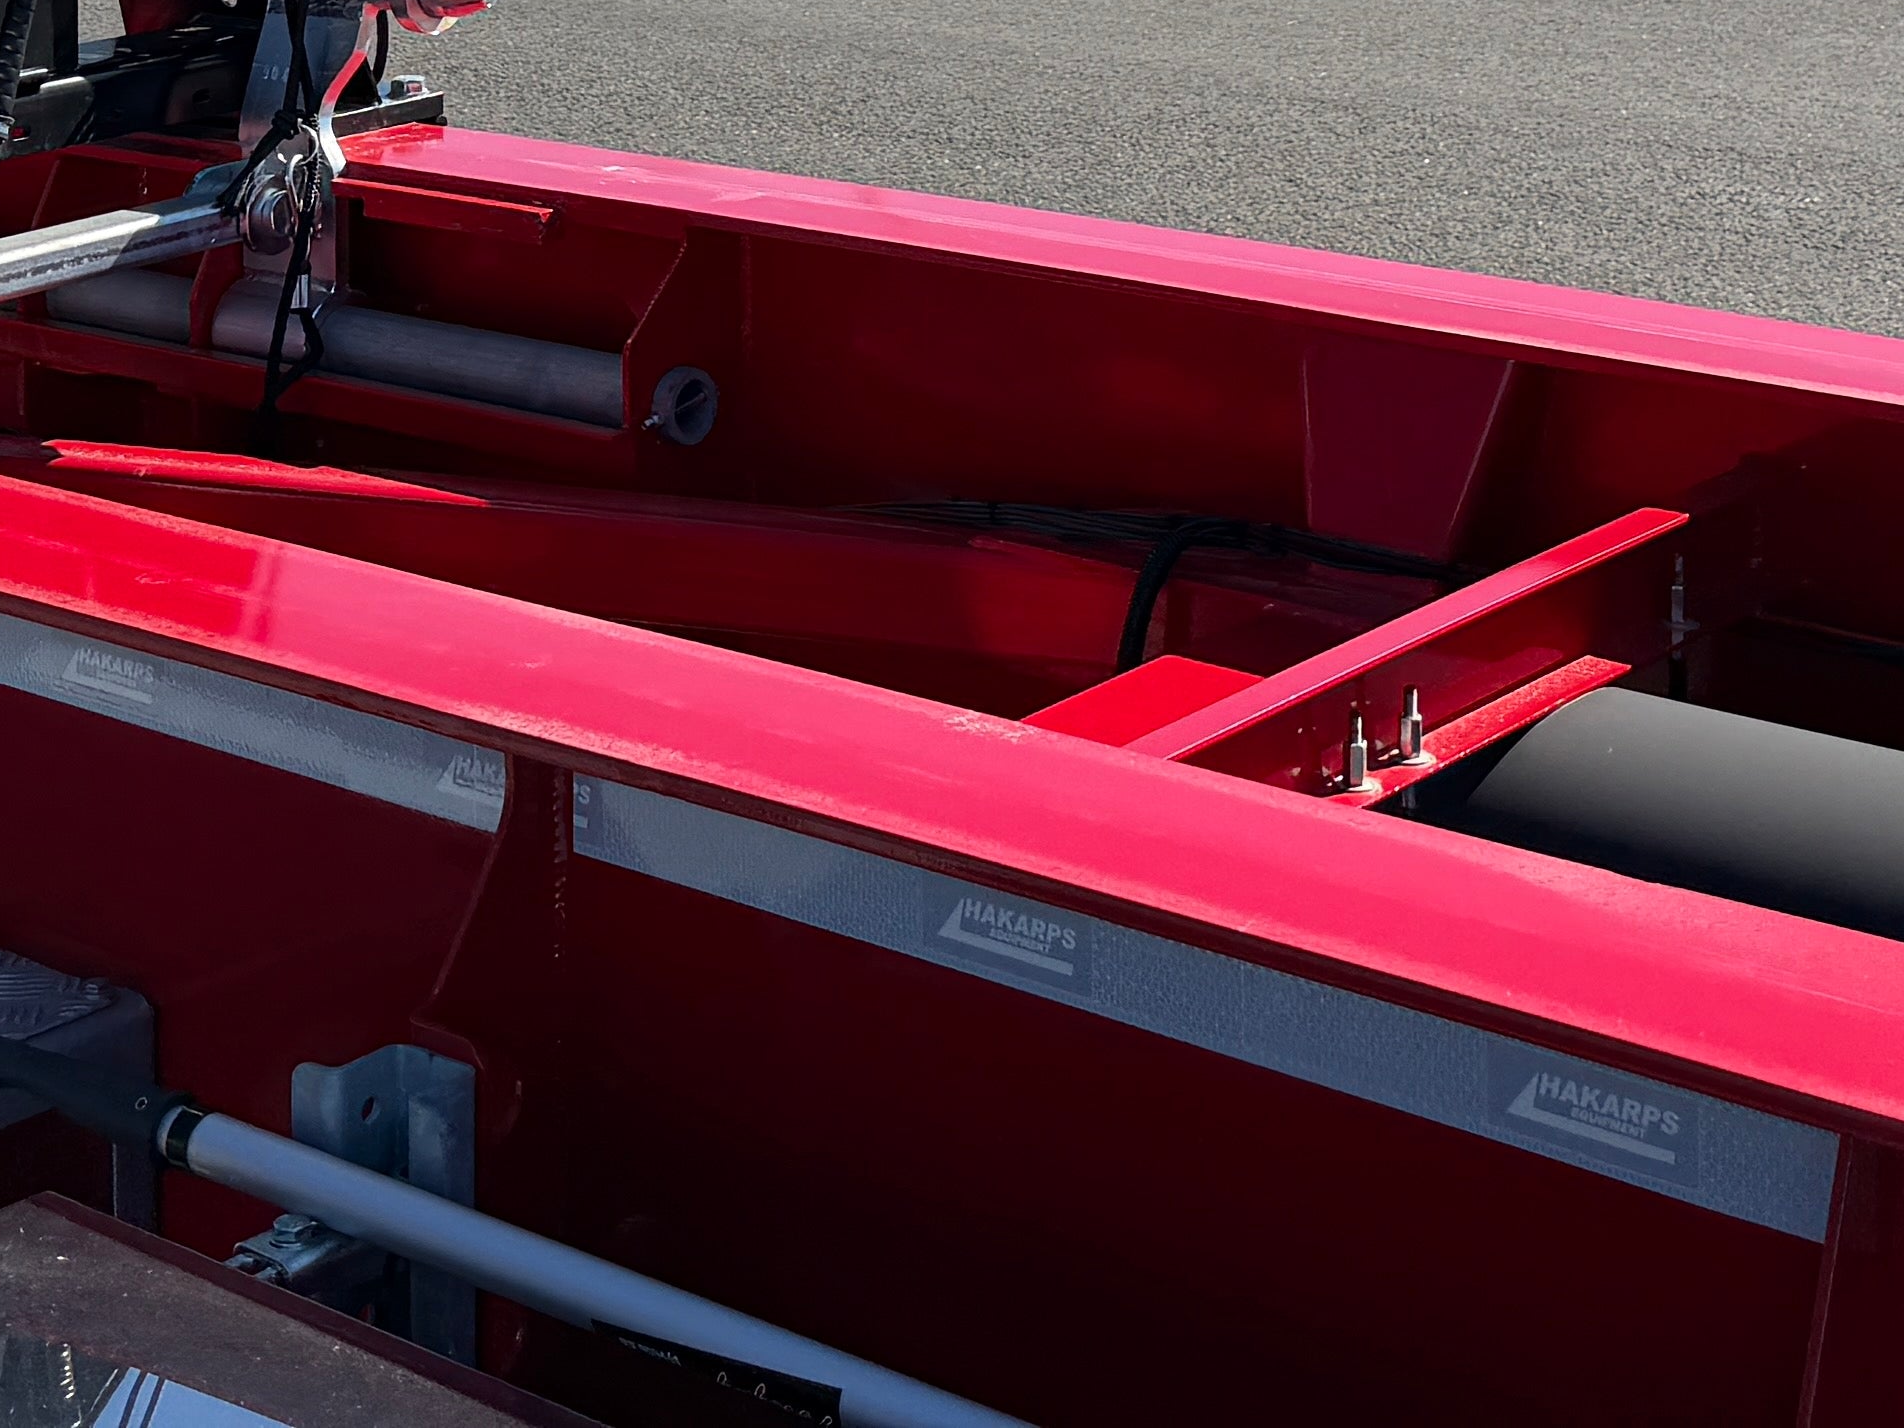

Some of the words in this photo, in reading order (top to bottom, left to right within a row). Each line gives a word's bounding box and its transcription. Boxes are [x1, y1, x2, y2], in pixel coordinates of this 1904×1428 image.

[79, 647, 154, 684] HAKARPS
[963, 897, 1077, 950] HAKARPS
[1539, 1072, 1680, 1136] HAKARPS
